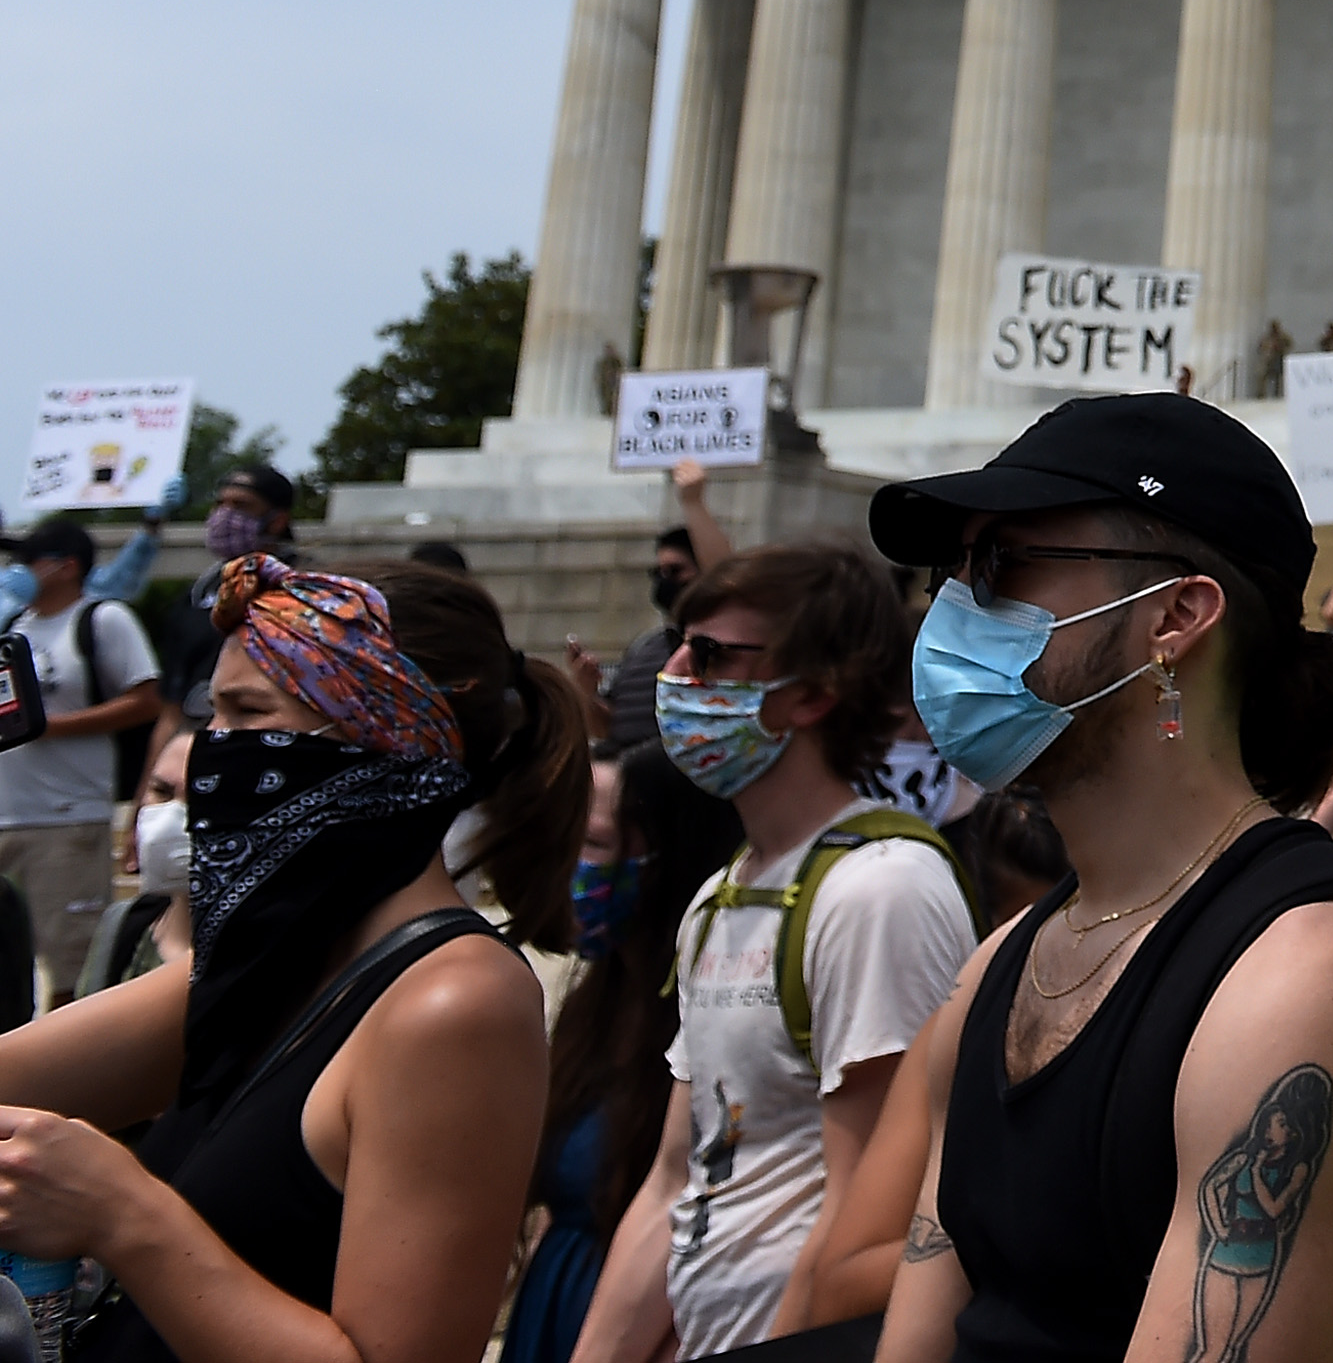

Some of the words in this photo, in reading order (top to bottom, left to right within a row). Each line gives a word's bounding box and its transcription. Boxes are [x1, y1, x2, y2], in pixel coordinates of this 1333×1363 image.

[1020, 265, 1121, 312] FUCK
[1134, 274, 1191, 312] THE
[993, 318, 1174, 378] SYSTEM
